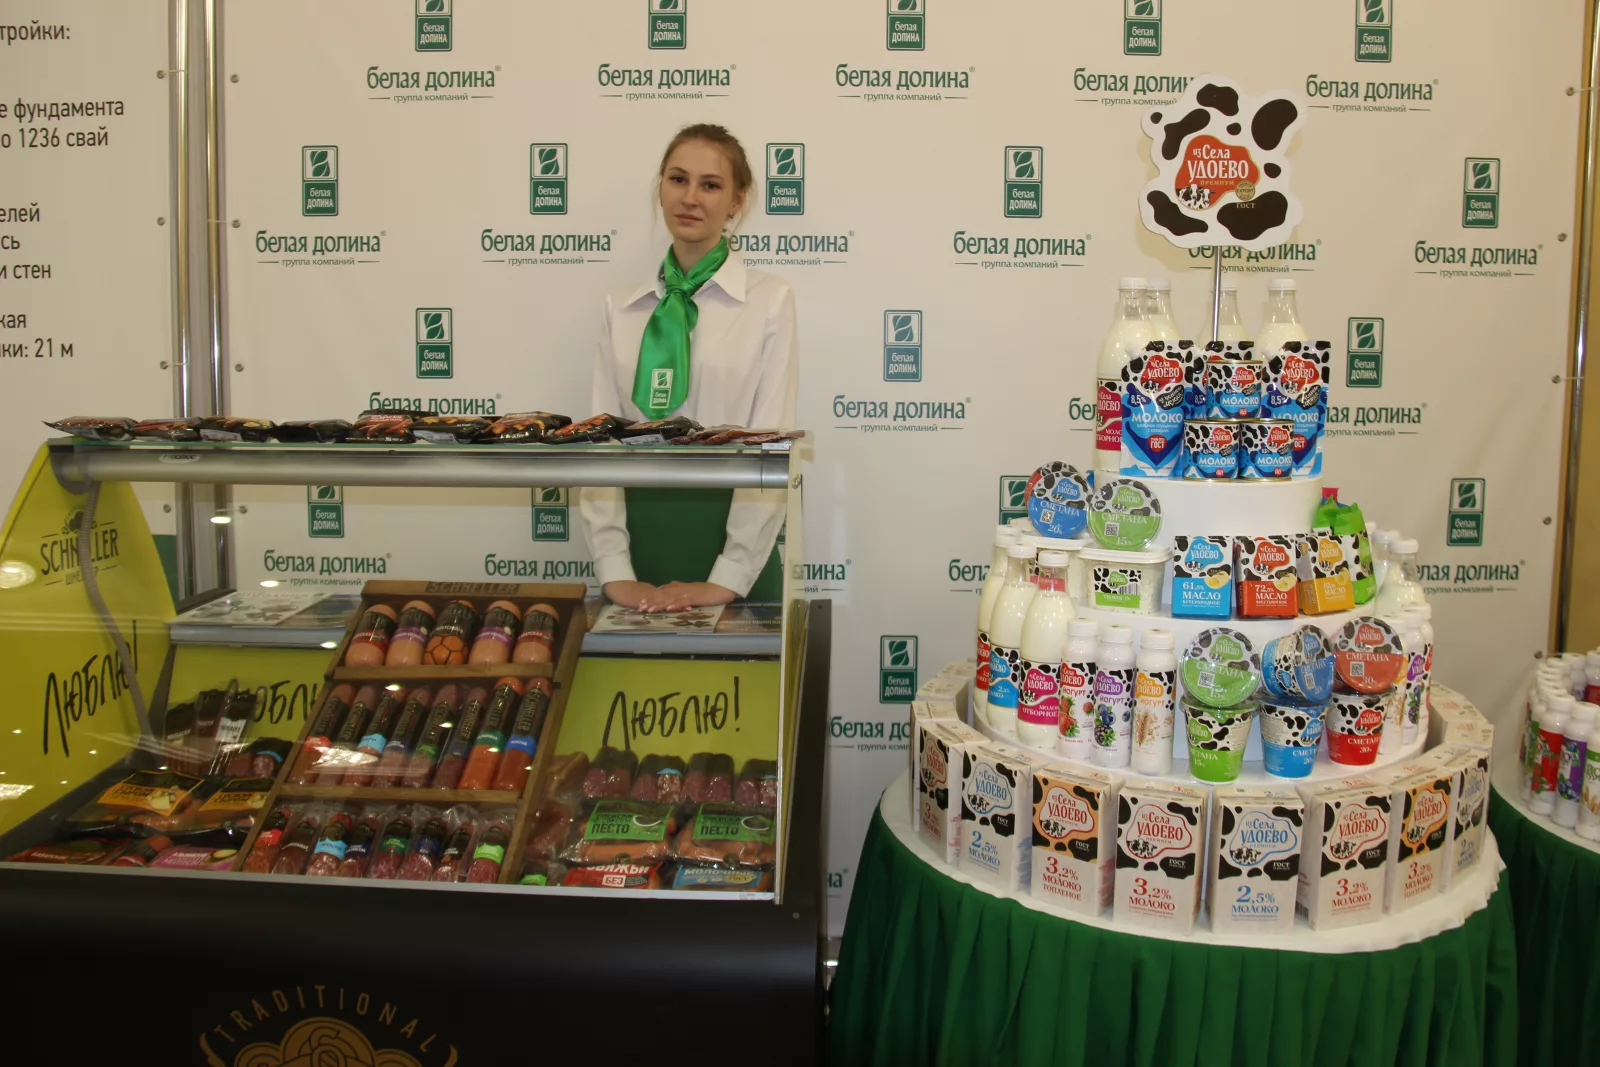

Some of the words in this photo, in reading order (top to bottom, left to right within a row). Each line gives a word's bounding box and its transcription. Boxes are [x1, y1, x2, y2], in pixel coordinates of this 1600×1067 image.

[423, 22, 445, 33] белая
[656, 21, 679, 31] белая
[895, 22, 917, 32] белая
[1132, 26, 1154, 37] белая
[420, 33, 448, 45] ДОЛИНА
[653, 30, 682, 43] ДОЛИНА
[892, 31, 920, 43] ДОЛИНА
[1128, 37, 1157, 48] ДОЛИНА
[1363, 34, 1385, 43] белая
[1360, 43, 1388, 55] ДОЛИНА
[366, 66, 420, 89] белая
[424, 68, 495, 91] долина
[598, 64, 653, 87] белая
[658, 68, 731, 89] долина
[836, 64, 892, 88] белая
[896, 69, 969, 91] долина
[1074, 68, 1129, 91] белая
[1306, 74, 1359, 98] белая
[1364, 80, 1433, 102] долина
[425, 93, 469, 102] компаний
[658, 91, 703, 99] компаний
[896, 92, 942, 101] компаний
[14, 98, 124, 123] фундамента
[1364, 104, 1406, 112] компаний
[19, 128, 60, 148] 1236
[66, 126, 109, 147] свай
[1193, 148, 1202, 158] из
[1203, 145, 1230, 160] Села
[1188, 160, 1249, 183] УДОЕВО
[310, 188, 331, 198] белая
[538, 185, 560, 196] белая
[774, 186, 796, 196] белая
[1012, 189, 1034, 199] белая
[306, 198, 334, 210] ДОЛИНА
[535, 196, 562, 208] ДОЛИНА
[771, 196, 799, 208] ДОЛИНА
[1009, 199, 1038, 211] ДОЛИНА
[1470, 200, 1492, 209] белая
[1467, 209, 1494, 221] ДОЛИНА
[1, 236, 21, 250] сь
[256, 231, 308, 253] белая
[312, 235, 380, 255] долина
[481, 229, 535, 252] белая
[540, 234, 611, 254] долина
[776, 235, 848, 255] долина
[953, 231, 1008, 255] белая
[1014, 236, 1086, 257] долина
[1415, 240, 1466, 265] белая
[1471, 246, 1538, 266] долина
[539, 256, 584, 264] компаний
[981, 260, 1012, 269] группа
[1013, 260, 1058, 268] компаний
[13, 264, 52, 279] стен
[34, 338, 53, 358] 21
[61, 344, 74, 358] м
[424, 350, 445, 360] белая
[892, 352, 914, 362] белая
[421, 360, 448, 372] ДОЛИНА
[889, 363, 917, 374] ДОЛИНА
[1147, 367, 1180, 379] УДОЕВО
[1286, 368, 1314, 380] УДОЕВО
[1131, 395, 1147, 407] 8,5%
[1222, 397, 1259, 406] МОЛОКО
[833, 395, 888, 418] белая
[893, 399, 966, 421] долина
[1132, 413, 1183, 423] МОЛОКО
[1272, 413, 1319, 422] МОЛОКО
[1354, 407, 1421, 426] долина
[861, 424, 891, 433] группа
[893, 423, 938, 432] компаний
[1151, 441, 1165, 449] ГОСТ
[1199, 457, 1236, 465] МОЛОКО
[1040, 501, 1080, 518] СМЕТАНА
[540, 513, 562, 523] белая
[1102, 513, 1147, 525] СМЕТАНА
[537, 524, 564, 534] ДОЛИНА
[1191, 550, 1219, 560] УДОЕВО
[1258, 553, 1285, 562] УДОЕВО
[264, 550, 315, 573] белая
[319, 555, 387, 576] долина
[485, 553, 538, 577] белая
[1454, 564, 1519, 584] долина
[1183, 591, 1221, 600] МАСЛО
[1256, 592, 1288, 600] МАСЛО
[1346, 653, 1390, 662] СМЕТАНА
[1196, 661, 1244, 680] СМЕТАНА
[888, 676, 909, 686] белая
[1028, 679, 1054, 690] УДОЕВО
[884, 686, 912, 697] ДОЛИНА
[1100, 695, 1125, 706] йогурт
[1140, 697, 1165, 707] йогурт
[1022, 708, 1058, 718] ОТБОРНОЕ
[830, 716, 884, 738] белая
[857, 744, 887, 752] группа
[926, 754, 944, 776] УДОЕВО
[983, 770, 999, 784] Села
[975, 778, 1007, 801] УДОЕВО
[1057, 794, 1076, 808] Села
[1048, 801, 1088, 825] УДОЕВО
[1148, 811, 1170, 825] Села
[1350, 811, 1368, 822] Села
[1413, 802, 1442, 823] УДОЕВО
[592, 824, 630, 834] ПЕСТО
[701, 825, 739, 835] ПЕСТО
[1253, 818, 1275, 830] Села
[1339, 819, 1379, 840] УДОЕВО
[1137, 821, 1184, 842] УДОЕВО
[971, 830, 998, 856] 2,5%
[1241, 829, 1288, 847] УДОЕВО
[1075, 840, 1090, 850] ГОСТ
[968, 847, 1000, 867] МОЛОКО
[1169, 858, 1186, 867] ГОСТ
[1045, 856, 1078, 882] 3,2%
[1408, 862, 1432, 880] 3,2%
[605, 877, 624, 885] БЕЗ
[1042, 873, 1082, 892] МОЛОКО
[1404, 874, 1434, 891] МОЛОКО
[1043, 883, 1082, 901] ТОПЛЕНОЕ
[1133, 877, 1172, 901] 3,2%
[1336, 878, 1369, 897] 3,2%
[1236, 885, 1276, 904] 2,5%
[1129, 896, 1176, 912] МОЛОКО
[1332, 893, 1372, 909] МОЛОКО
[1232, 904, 1279, 914] МОЛОКО
[214, 985, 437, 1053] TRADITIONAL
